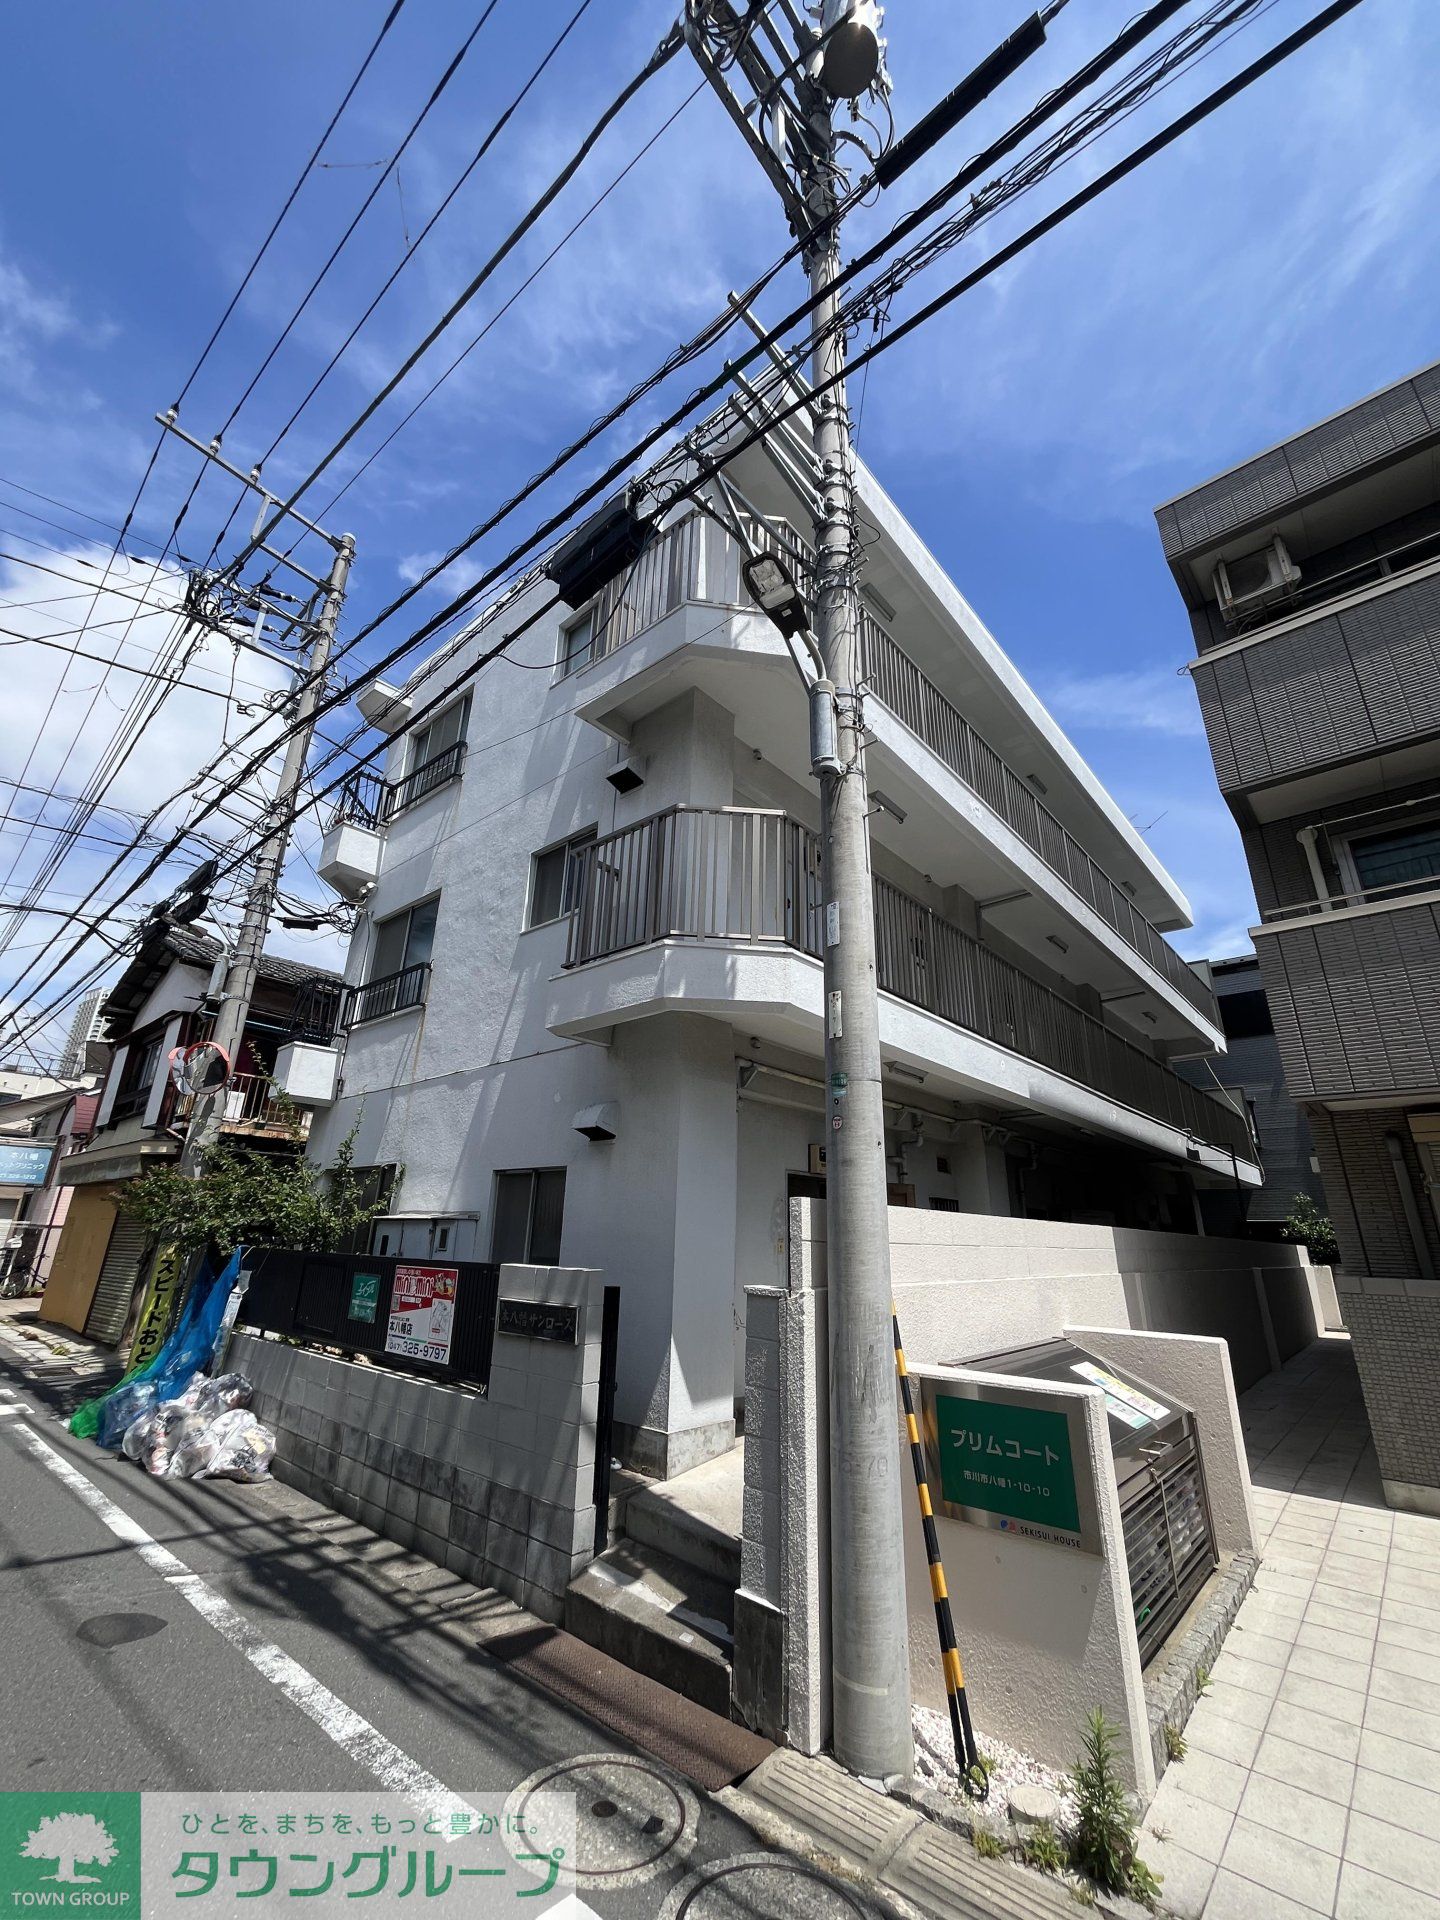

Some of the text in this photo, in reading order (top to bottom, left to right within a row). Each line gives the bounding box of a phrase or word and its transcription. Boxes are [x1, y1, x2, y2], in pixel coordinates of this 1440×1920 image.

[130, 1258, 175, 1373] スピードおと
[950, 1428, 1060, 1466] プリムコート
[1020, 1526, 1081, 1549] SEKISUI HOUSE
